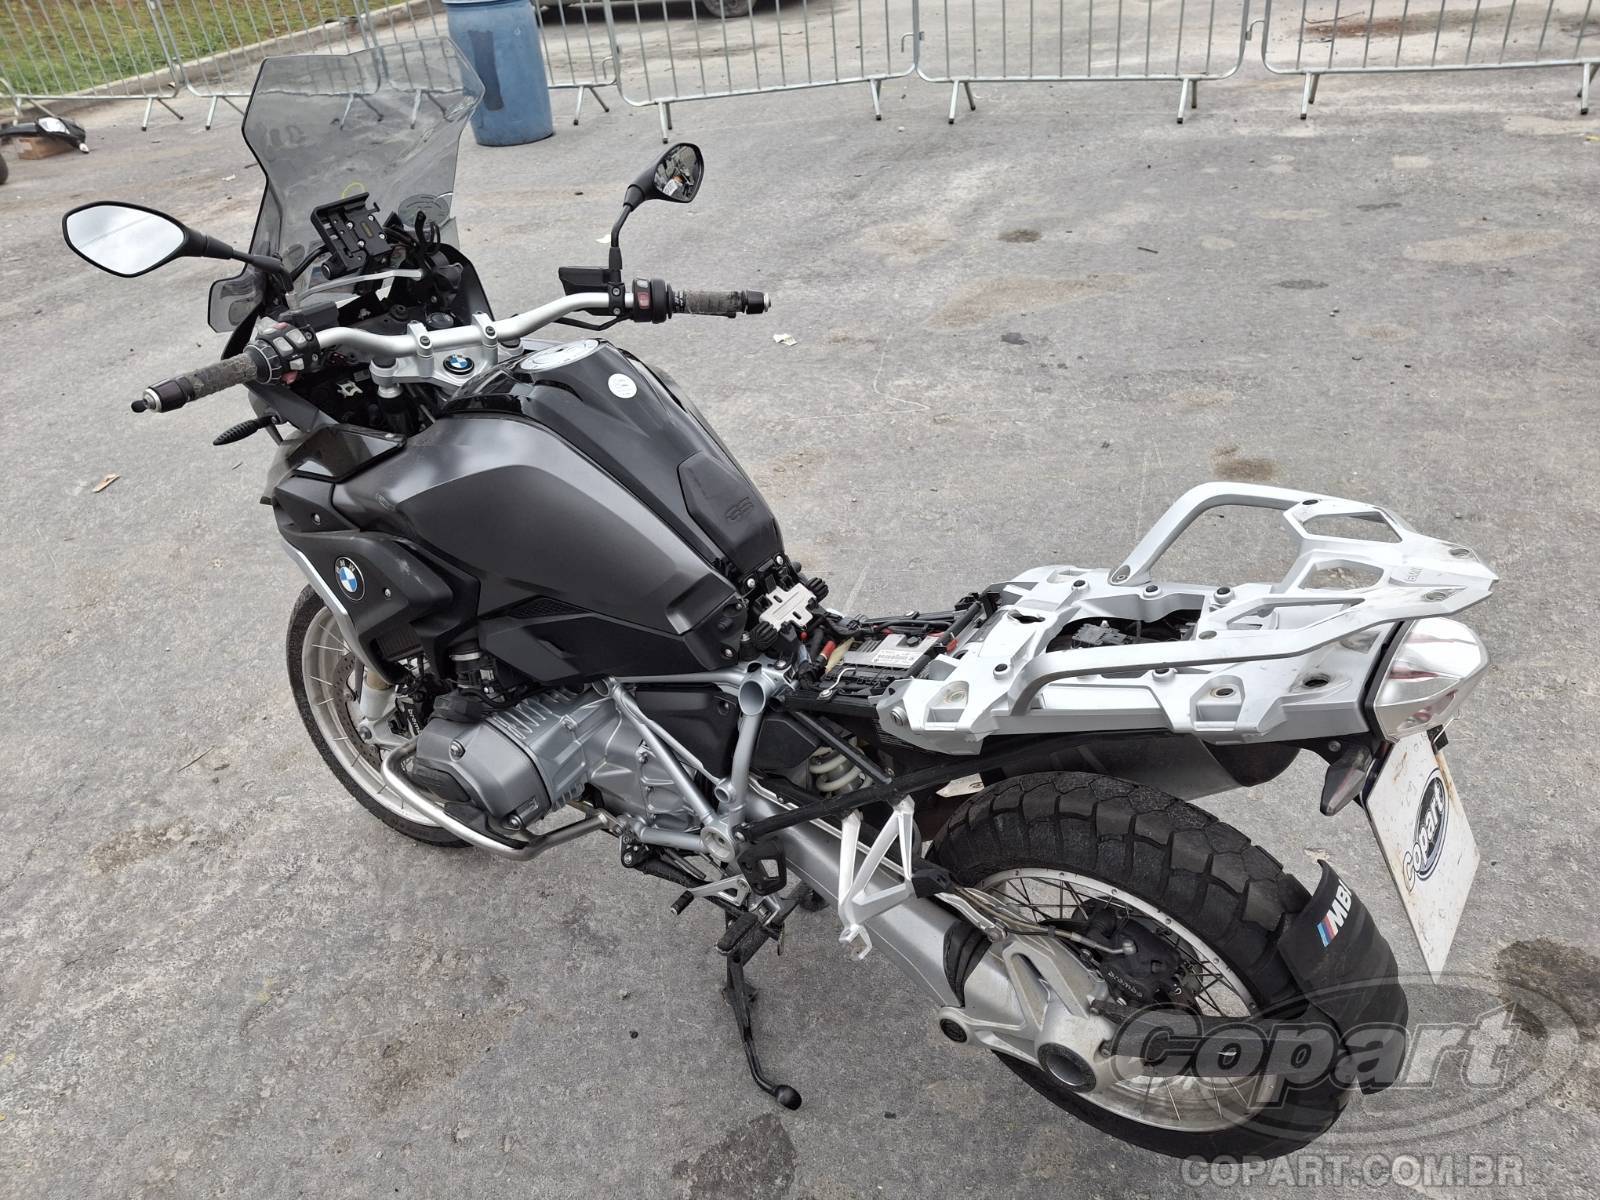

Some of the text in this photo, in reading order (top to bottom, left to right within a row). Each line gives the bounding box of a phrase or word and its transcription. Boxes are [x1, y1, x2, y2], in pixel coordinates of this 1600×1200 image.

[408, 708, 422, 736] brem
[1403, 781, 1444, 893] Copart
[1327, 878, 1352, 937] MB
